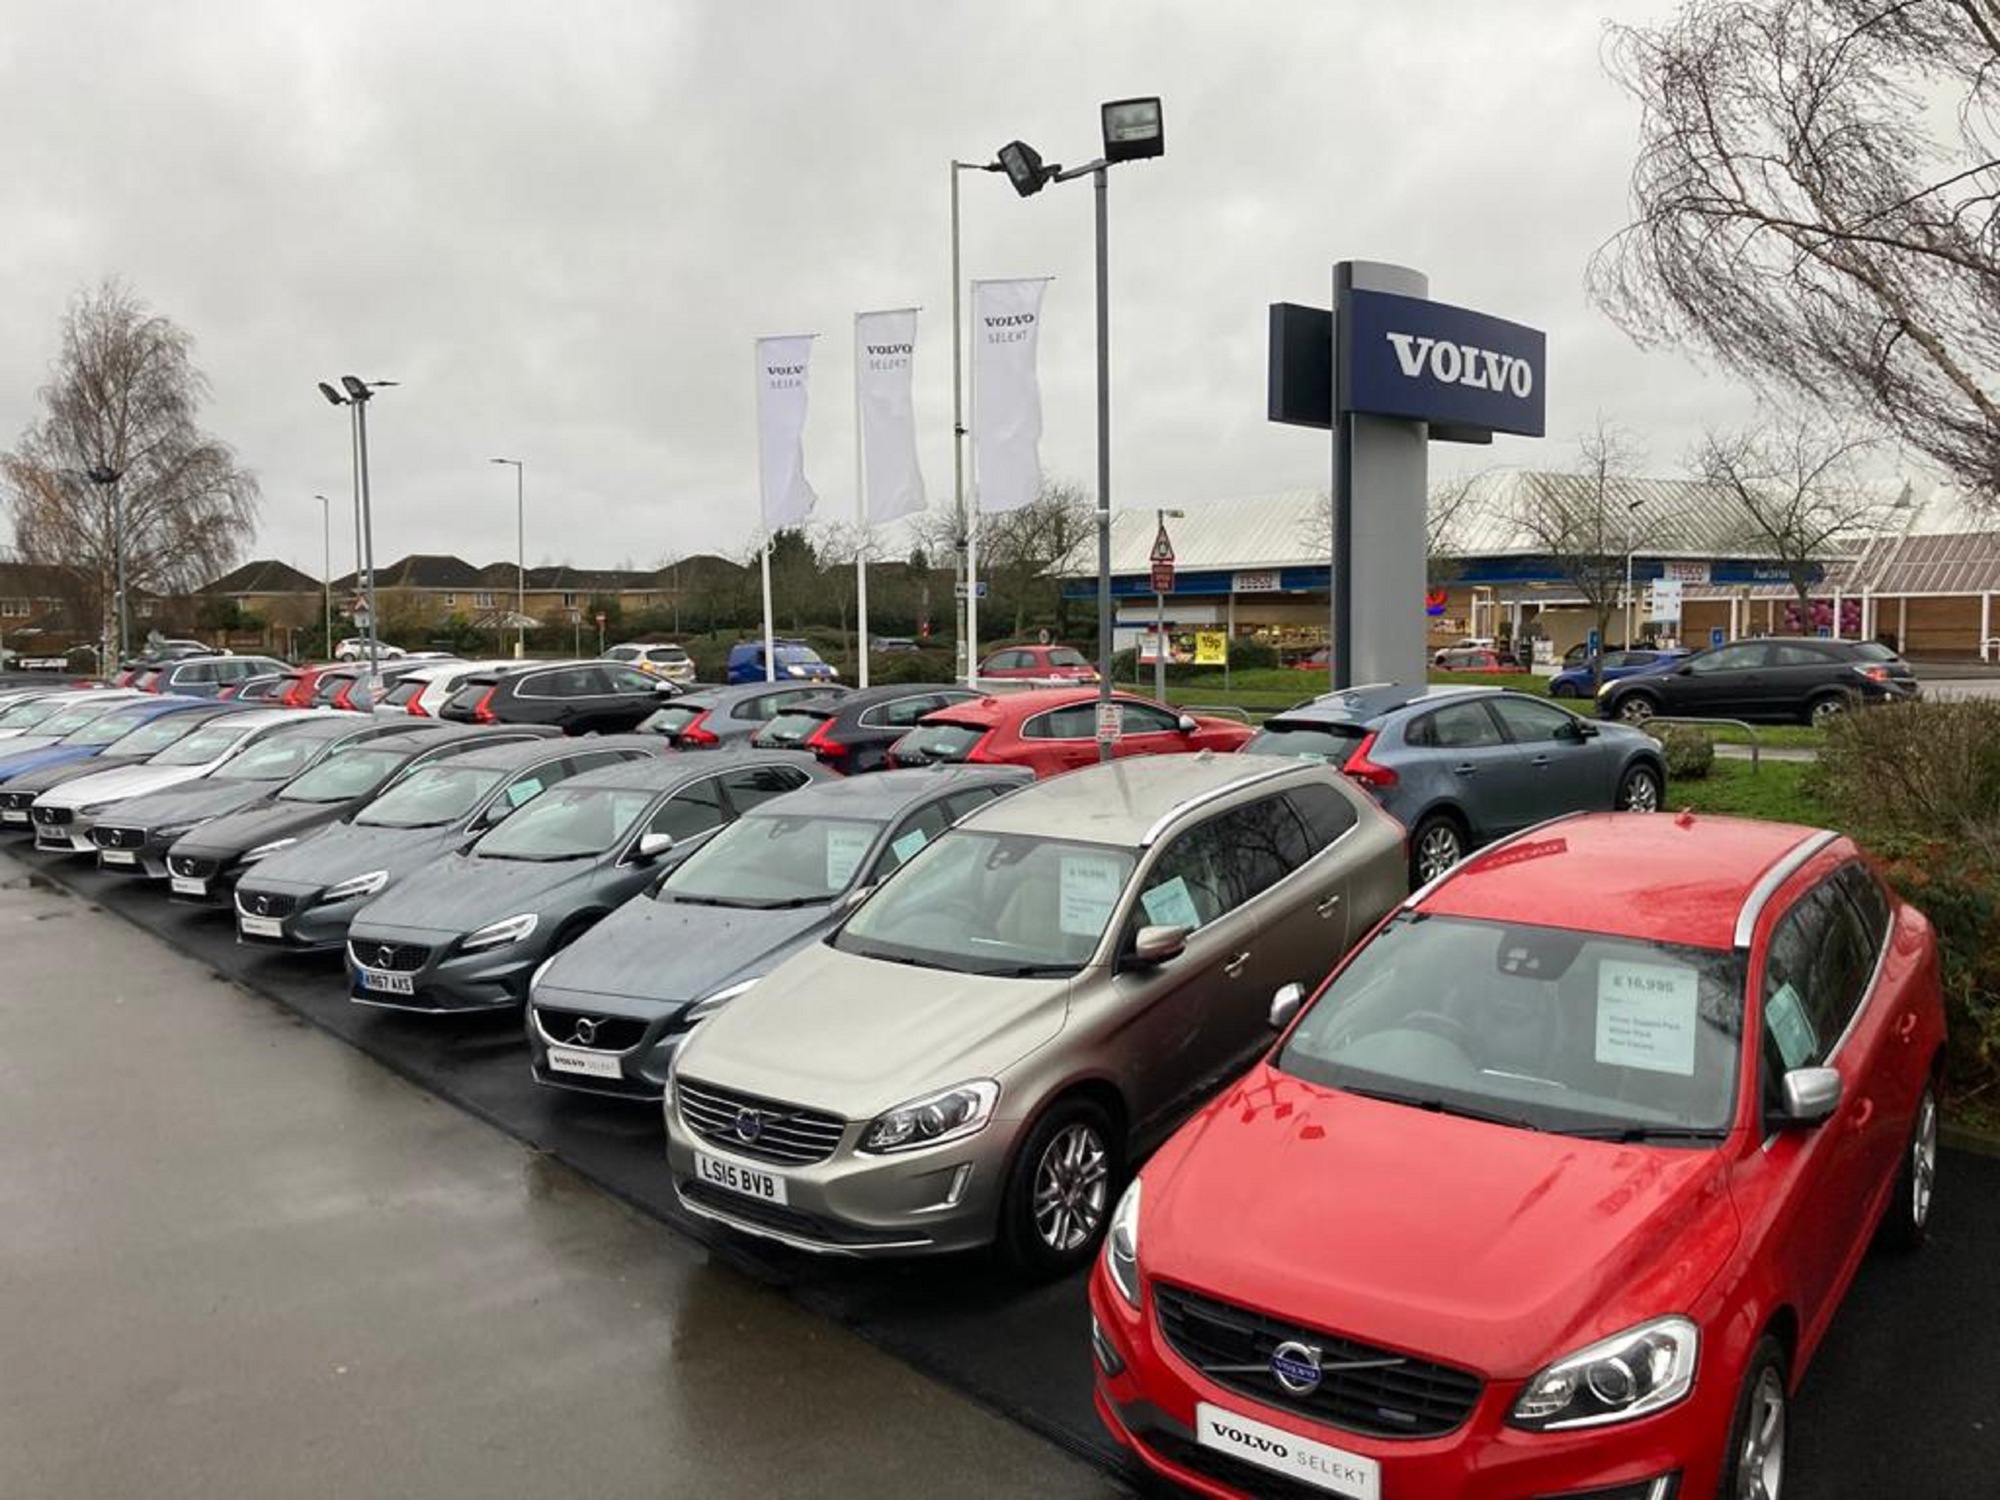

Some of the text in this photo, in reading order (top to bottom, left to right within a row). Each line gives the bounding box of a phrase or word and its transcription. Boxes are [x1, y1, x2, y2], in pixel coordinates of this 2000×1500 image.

[984, 314, 1034, 327] VOLVO
[867, 344, 912, 355] VOLVO
[767, 365, 804, 375] VOLV
[1386, 332, 1533, 398] VOLVO
[554, 1055, 585, 1067] VOLVO
[702, 1158, 774, 1197] LS15 BVB
[1275, 1359, 1316, 1378] VOLVO
[1211, 1421, 1366, 1485] VOLVO SELEKT
